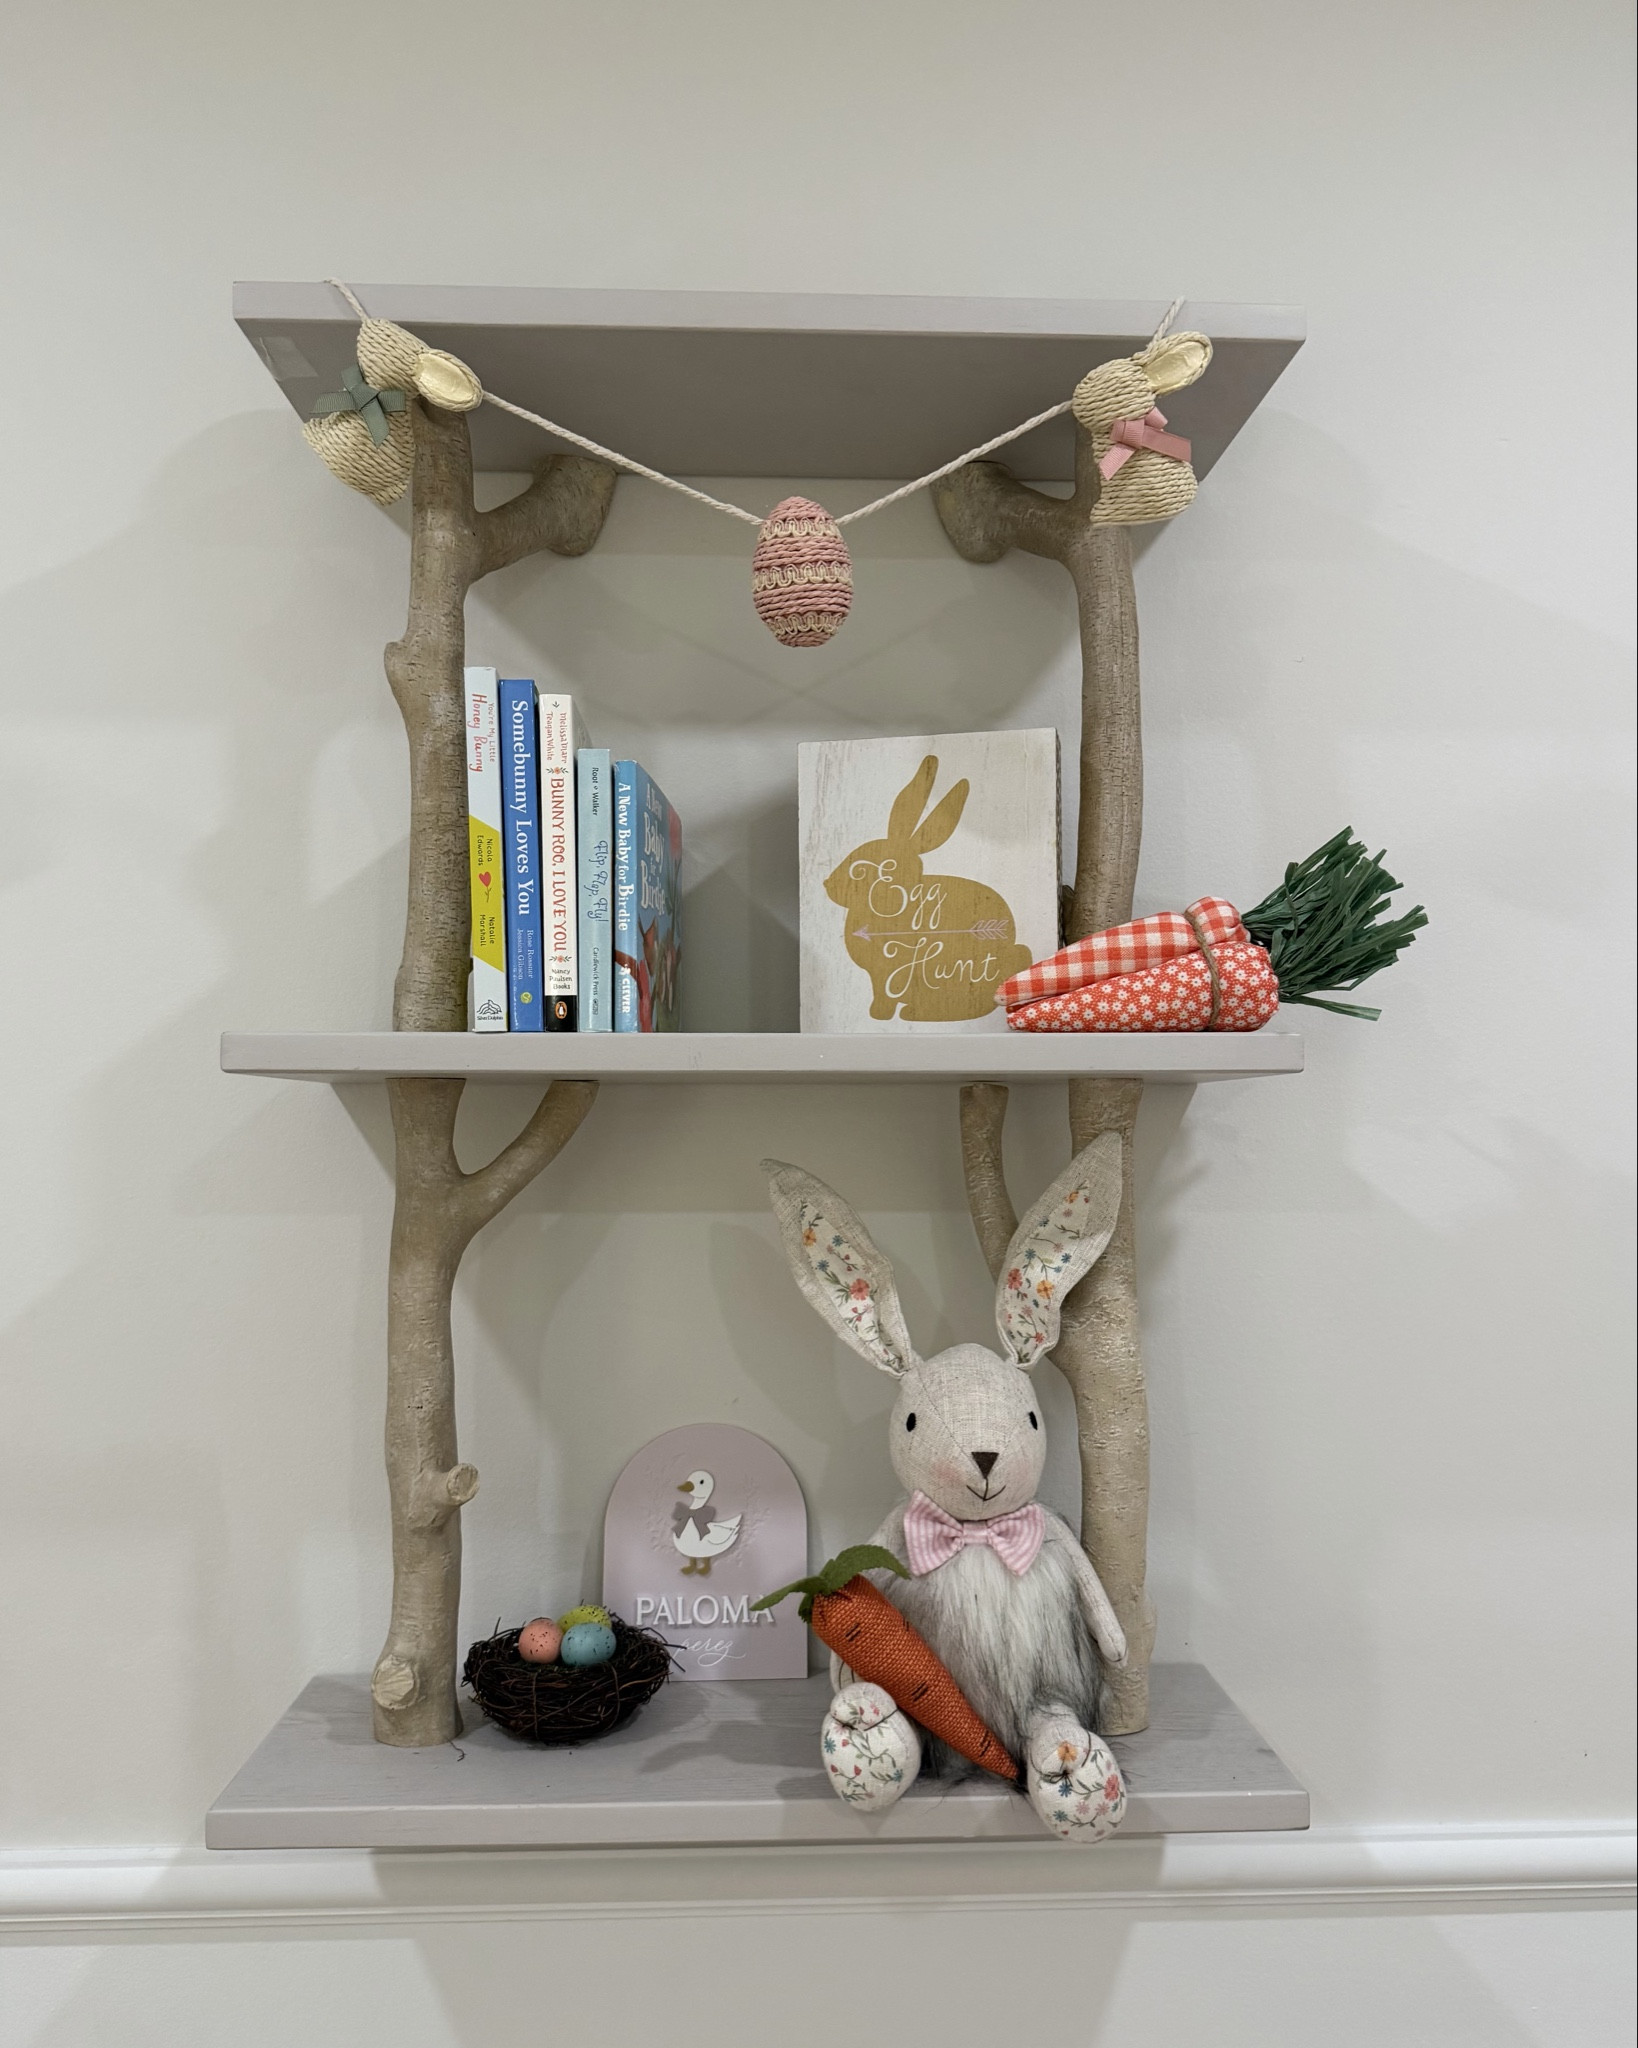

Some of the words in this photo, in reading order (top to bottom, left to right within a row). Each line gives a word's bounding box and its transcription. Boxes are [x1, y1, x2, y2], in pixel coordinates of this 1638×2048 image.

[467, 693, 488, 729] Honey
[487, 703, 495, 725] You're
[487, 730, 496, 738] My
[546, 739, 555, 761] White
[469, 735, 488, 772] Bunny
[510, 700, 532, 814] Somebunny
[592, 792, 600, 816] Walker
[618, 782, 631, 792] A
[550, 778, 565, 831] BUNNY
[618, 795, 631, 826] New
[515, 820, 533, 874] Loves
[551, 833, 565, 866] ROO,
[616, 829, 632, 863] Baby
[618, 865, 629, 883] for
[517, 879, 534, 915] You
[552, 881, 567, 918] LOVE
[587, 898, 609, 922] Fly!
[618, 884, 635, 931] Birdie
[849, 858, 947, 930] Egg
[553, 920, 567, 952] YOU
[883, 937, 999, 998] Hunt
[622, 977, 631, 1014] CLEVER
[636, 1594, 775, 1626] PALOMA
